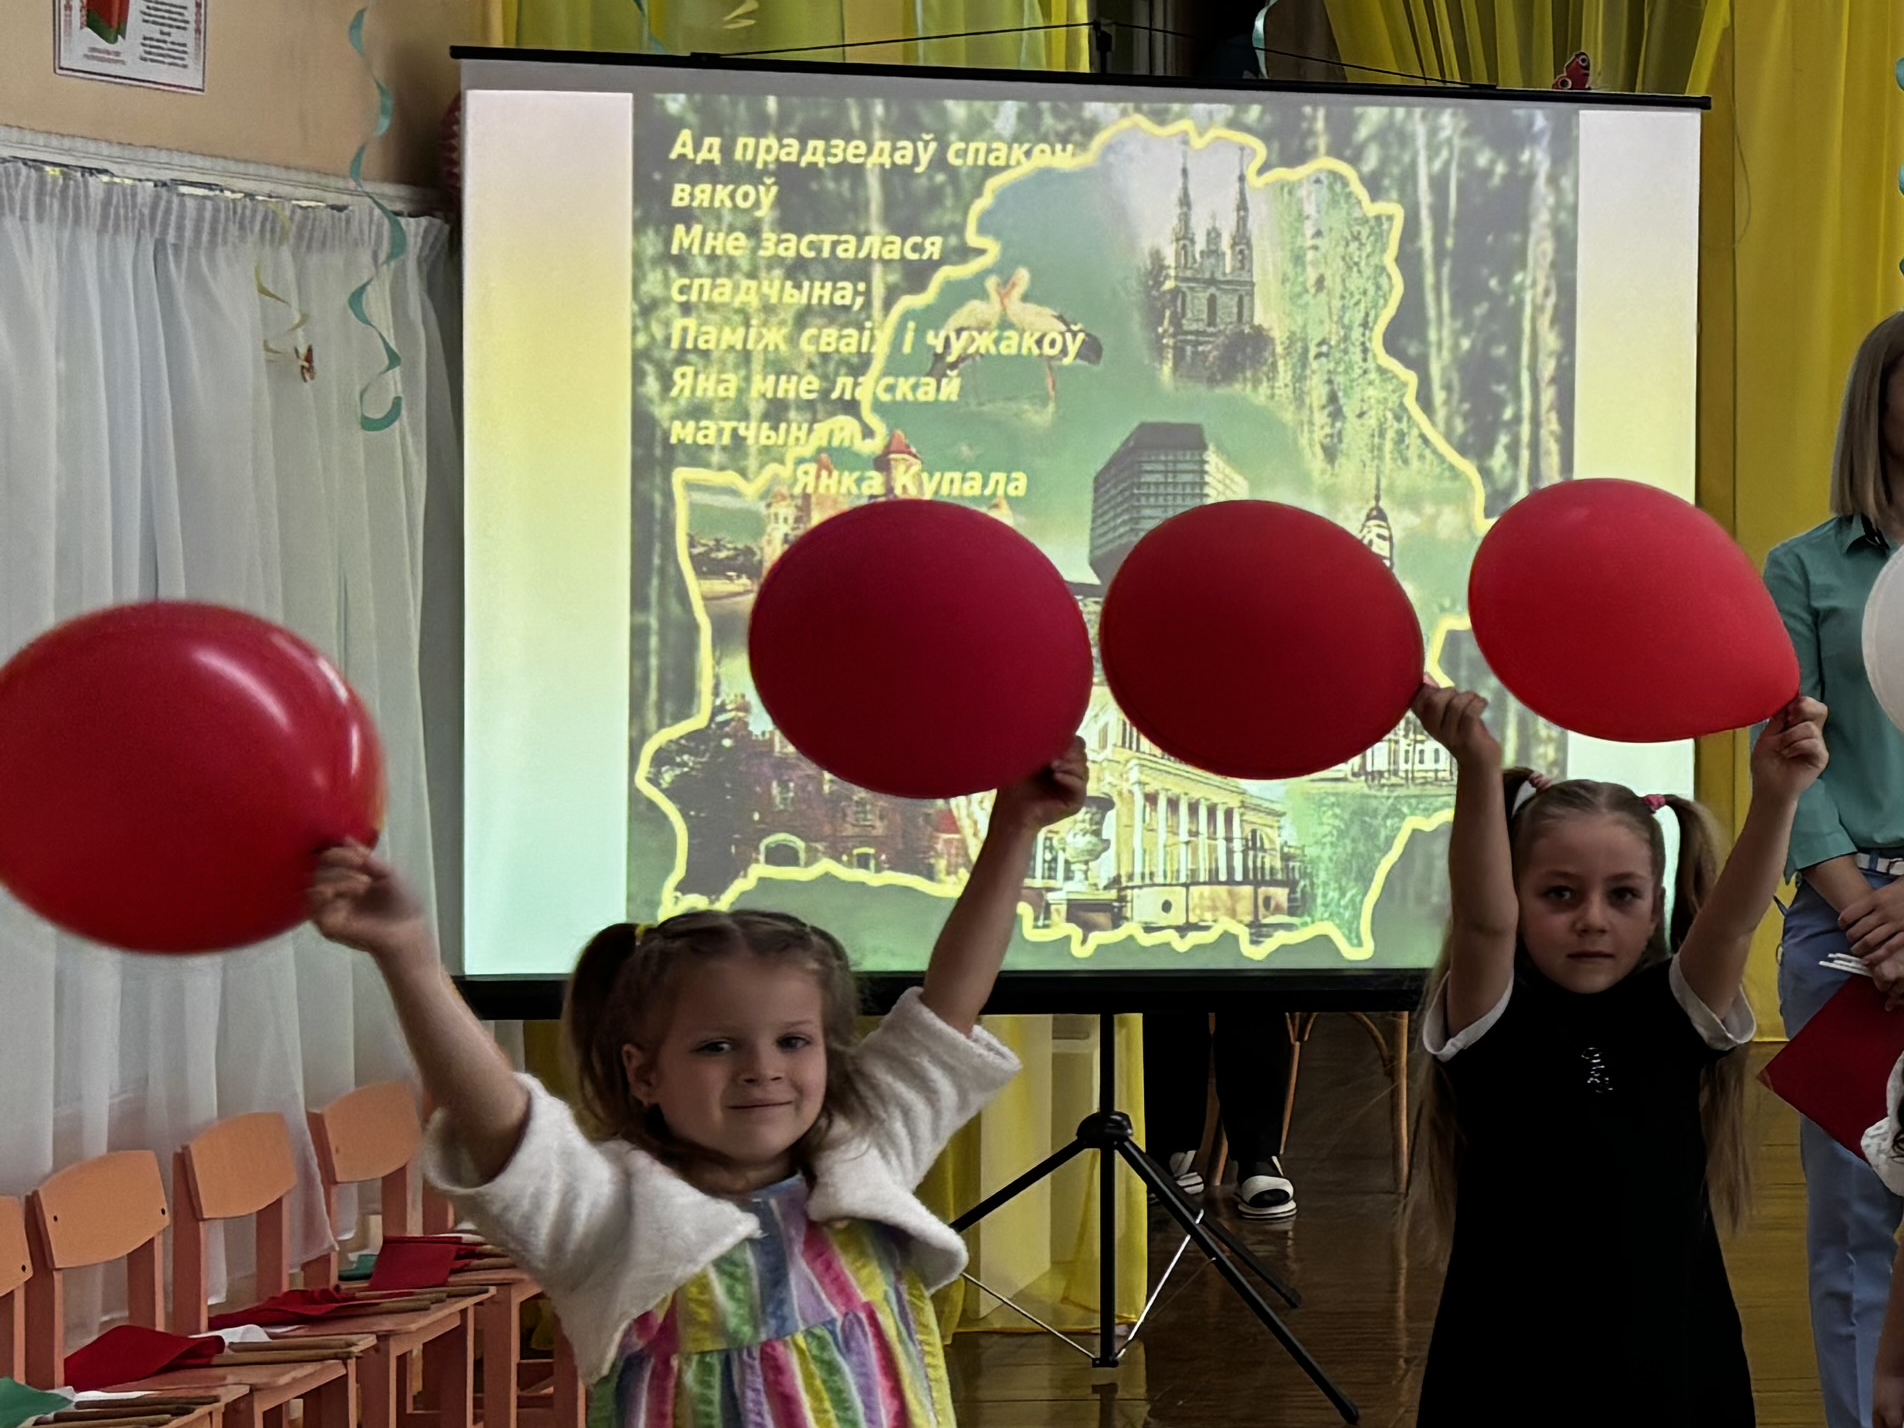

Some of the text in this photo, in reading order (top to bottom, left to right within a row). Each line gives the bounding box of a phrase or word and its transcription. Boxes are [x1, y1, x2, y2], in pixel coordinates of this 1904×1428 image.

[669, 128, 1076, 174] Ад прадзедаў спакон
[670, 176, 780, 218] вякоў
[669, 223, 944, 262] Мне засталася
[670, 276, 867, 310] спадчына;
[669, 318, 790, 353] Паміж
[902, 321, 917, 355] і
[926, 323, 1087, 366] чужакоў
[669, 365, 740, 401] Яна
[750, 373, 820, 402] мне
[793, 464, 1029, 502] Янка Купала
